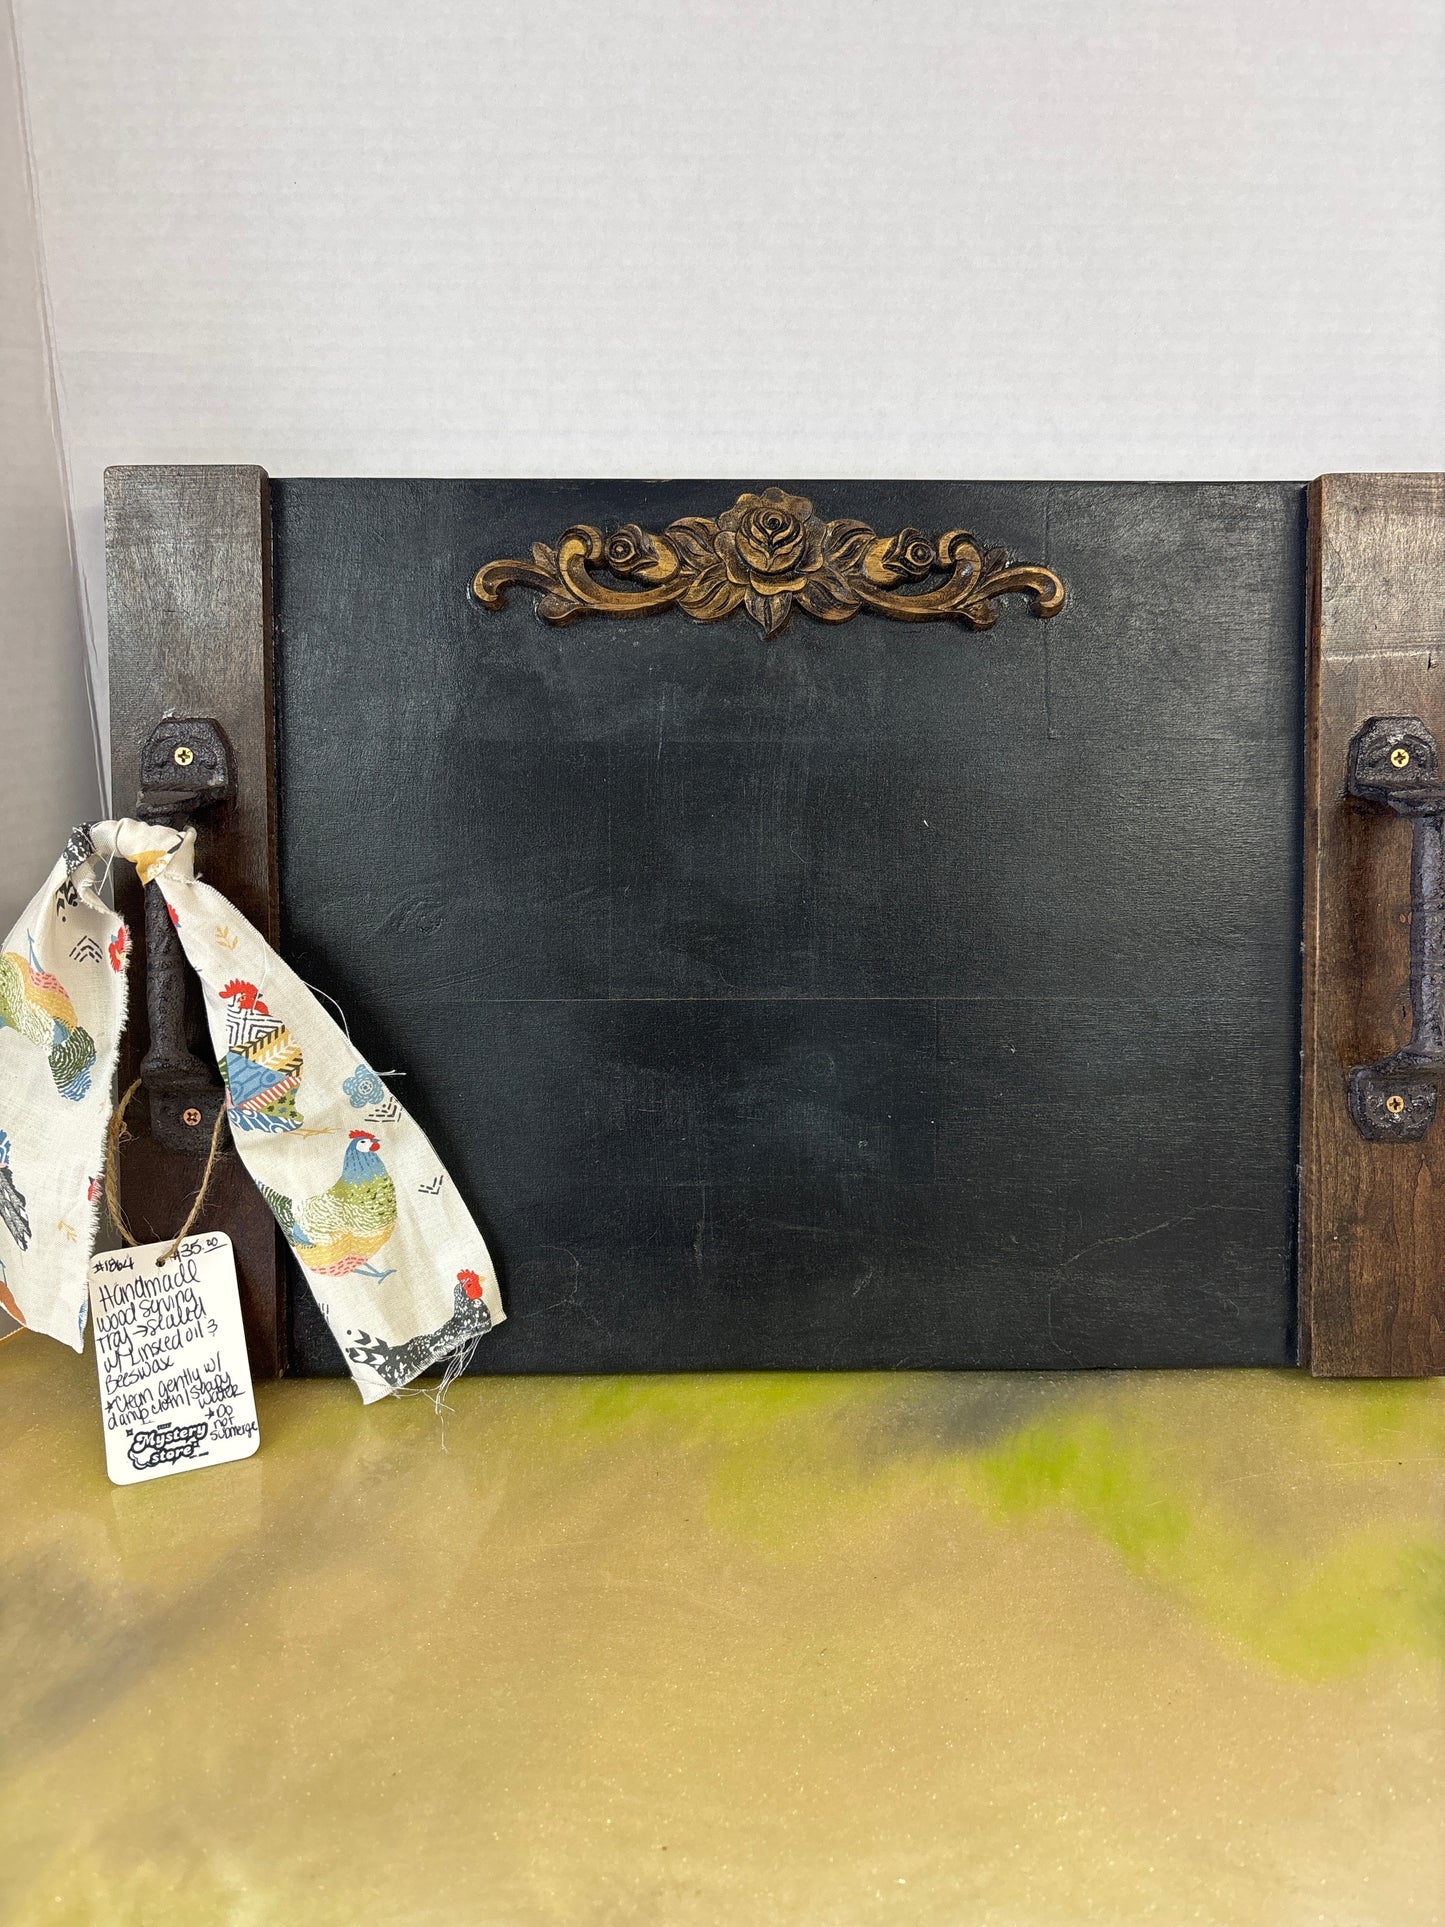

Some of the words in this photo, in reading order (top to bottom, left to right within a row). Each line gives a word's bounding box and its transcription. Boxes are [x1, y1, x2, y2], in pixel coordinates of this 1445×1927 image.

[185, 1320, 204, 1343] oil
[131, 1421, 208, 1454] Mystery
[150, 1445, 194, 1465] store
